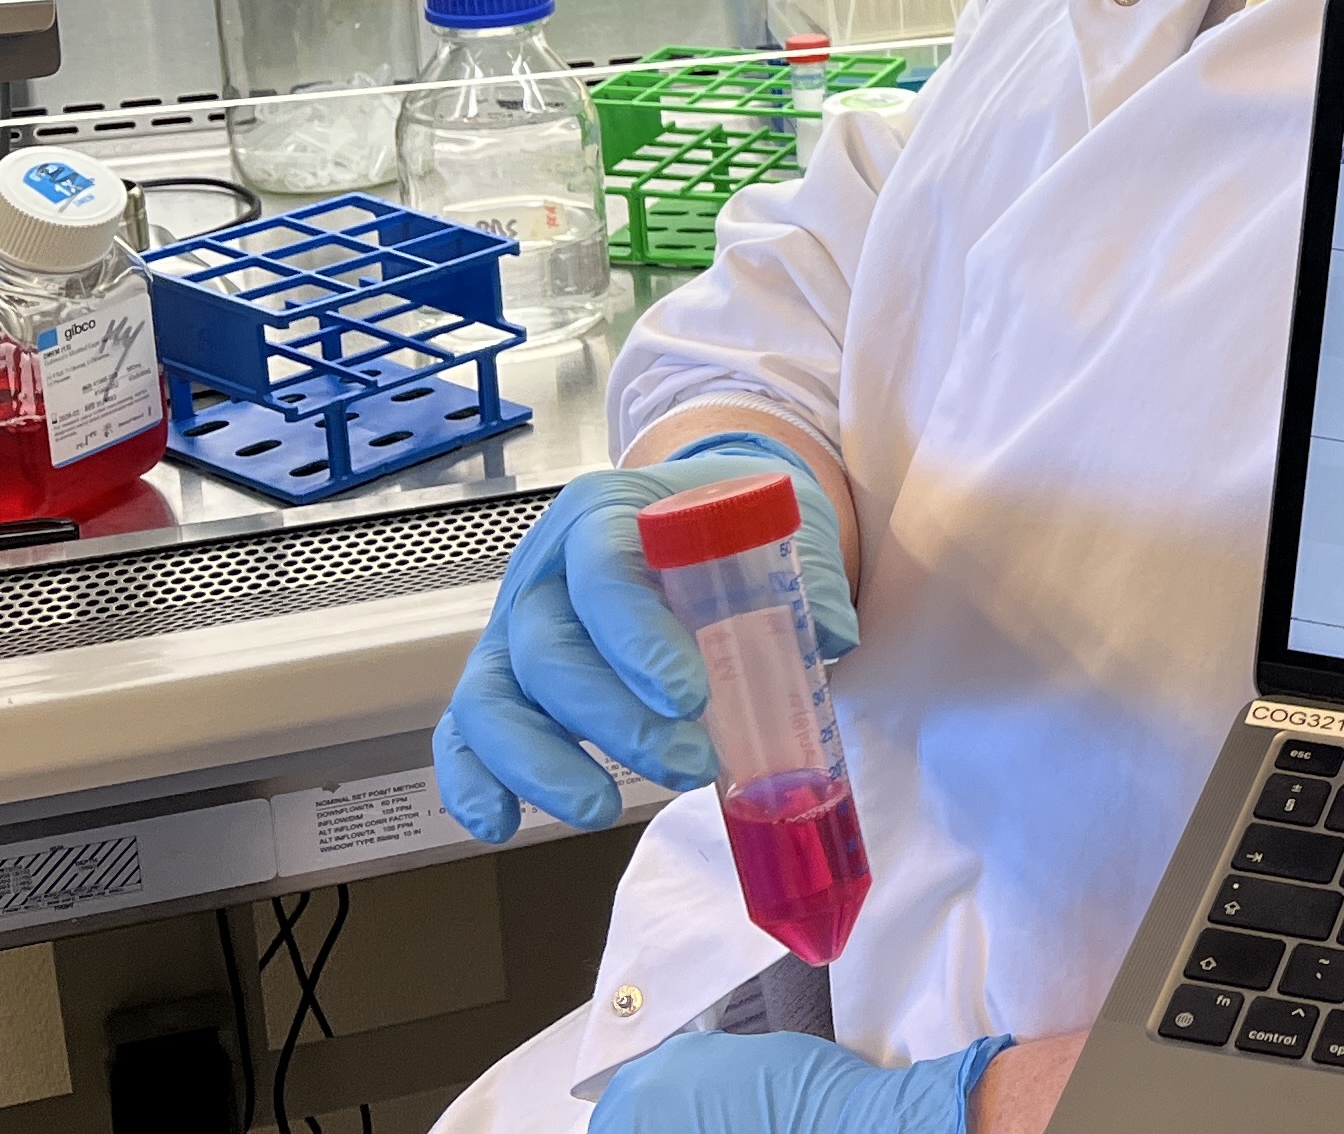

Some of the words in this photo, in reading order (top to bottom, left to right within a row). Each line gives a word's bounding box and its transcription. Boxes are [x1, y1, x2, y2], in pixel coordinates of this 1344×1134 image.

[64, 319, 97, 342] gibco
[1289, 749, 1312, 760] esc
[315, 794, 352, 808] NOMINAL
[351, 791, 367, 802] SET
[368, 787, 392, 799] POINT
[393, 781, 426, 794] METHOD
[388, 811, 420, 824] FACTOR
[355, 836, 376, 848] TYPE
[1216, 994, 1231, 1007] fn
[1248, 1030, 1298, 1046] control
